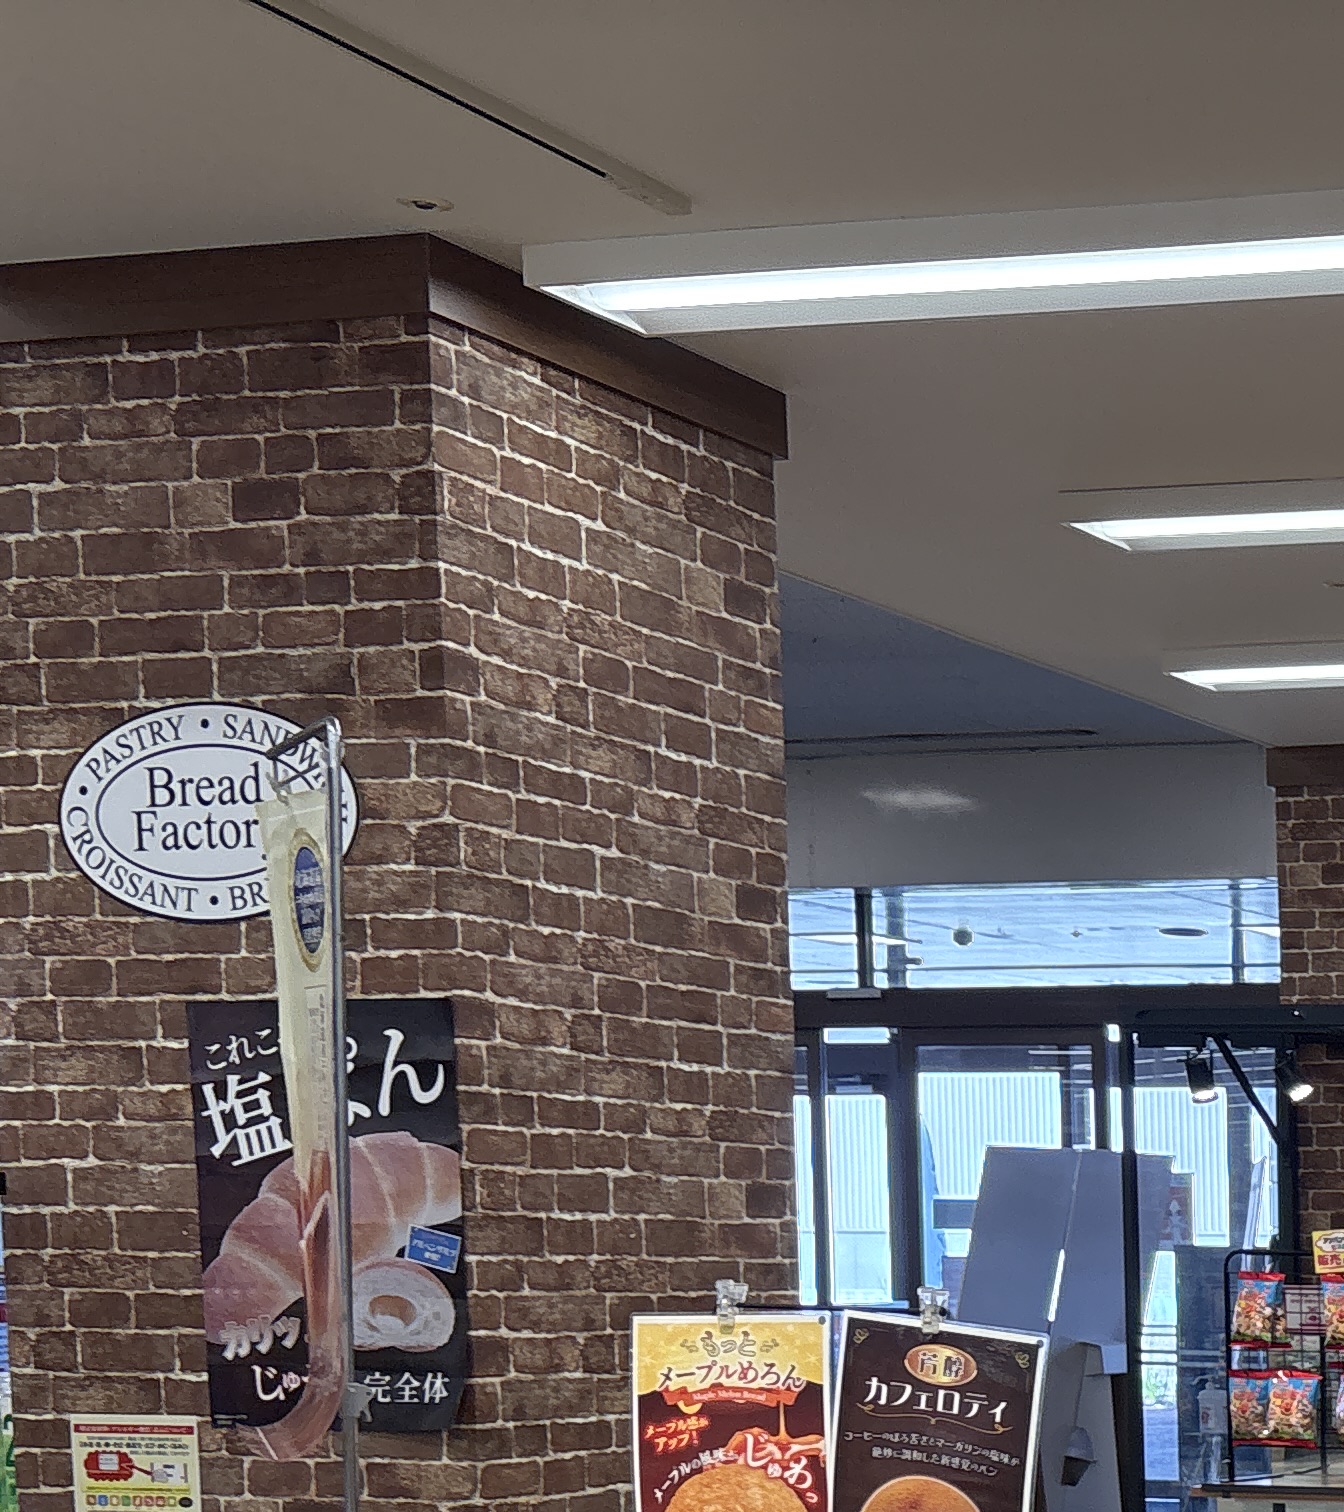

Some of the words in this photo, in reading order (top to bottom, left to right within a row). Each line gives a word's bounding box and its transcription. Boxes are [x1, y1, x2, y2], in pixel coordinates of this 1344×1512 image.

[85, 714, 186, 783] PASTRY
[146, 761, 264, 808] Bread
[132, 809, 266, 857] Factor
[65, 805, 198, 913] CROISSANT
[206, 1028, 284, 1070] これこ
[219, 1314, 308, 1361] カリッ
[700, 1330, 757, 1357] もっと
[658, 1359, 806, 1391] メープルめろん
[864, 1377, 1007, 1422] カフェロティ
